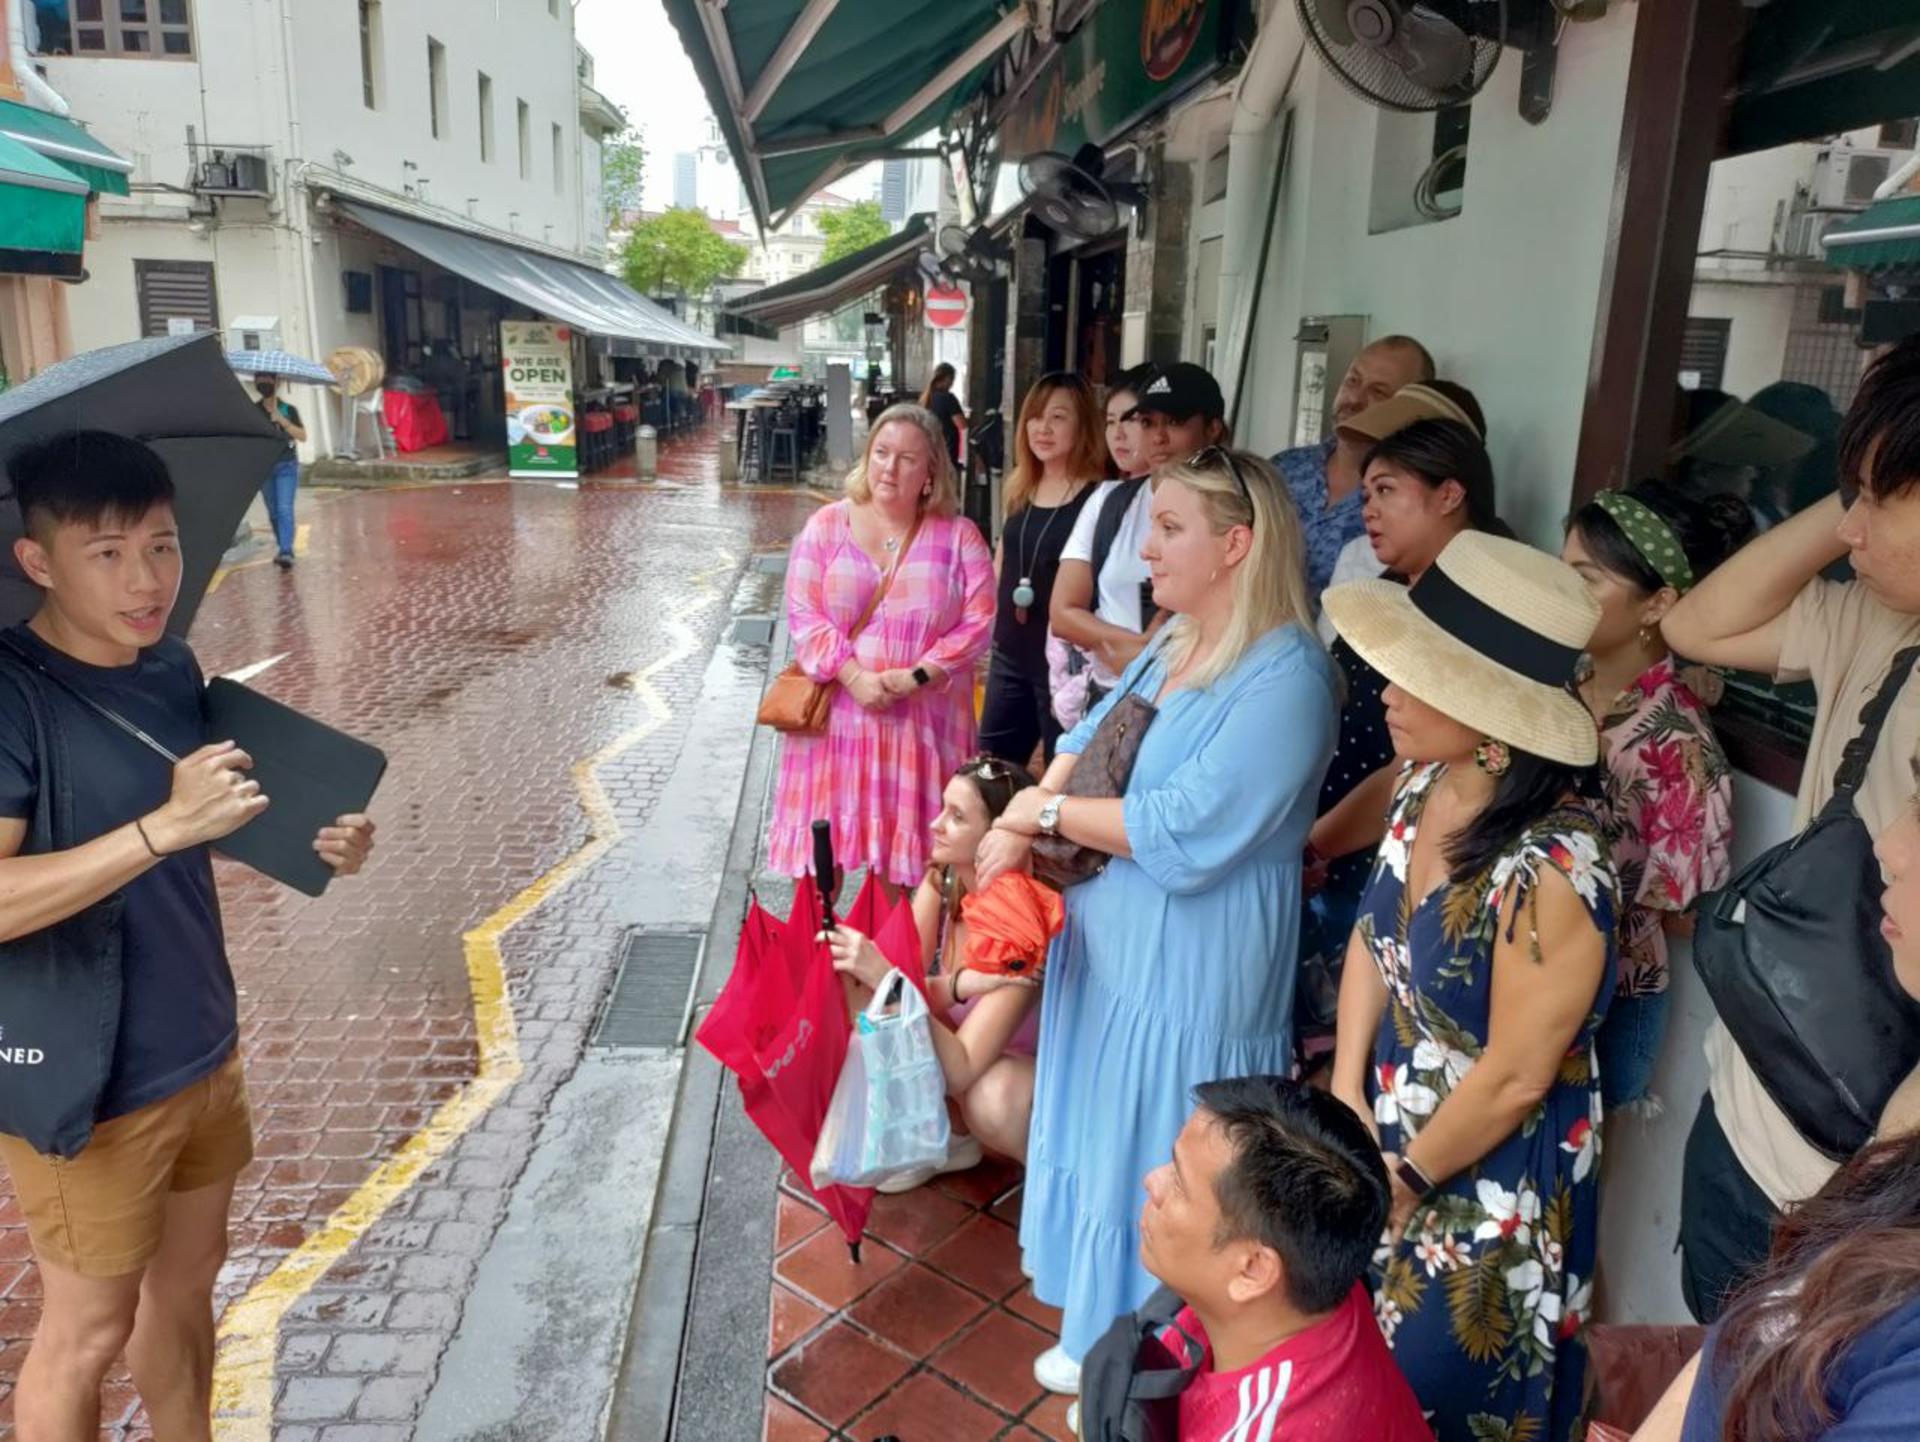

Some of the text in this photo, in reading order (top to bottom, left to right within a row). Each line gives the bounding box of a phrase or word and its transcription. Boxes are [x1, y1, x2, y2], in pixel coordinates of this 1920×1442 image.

[514, 357, 561, 367] WE ARE
[510, 368, 566, 383] OPEN
